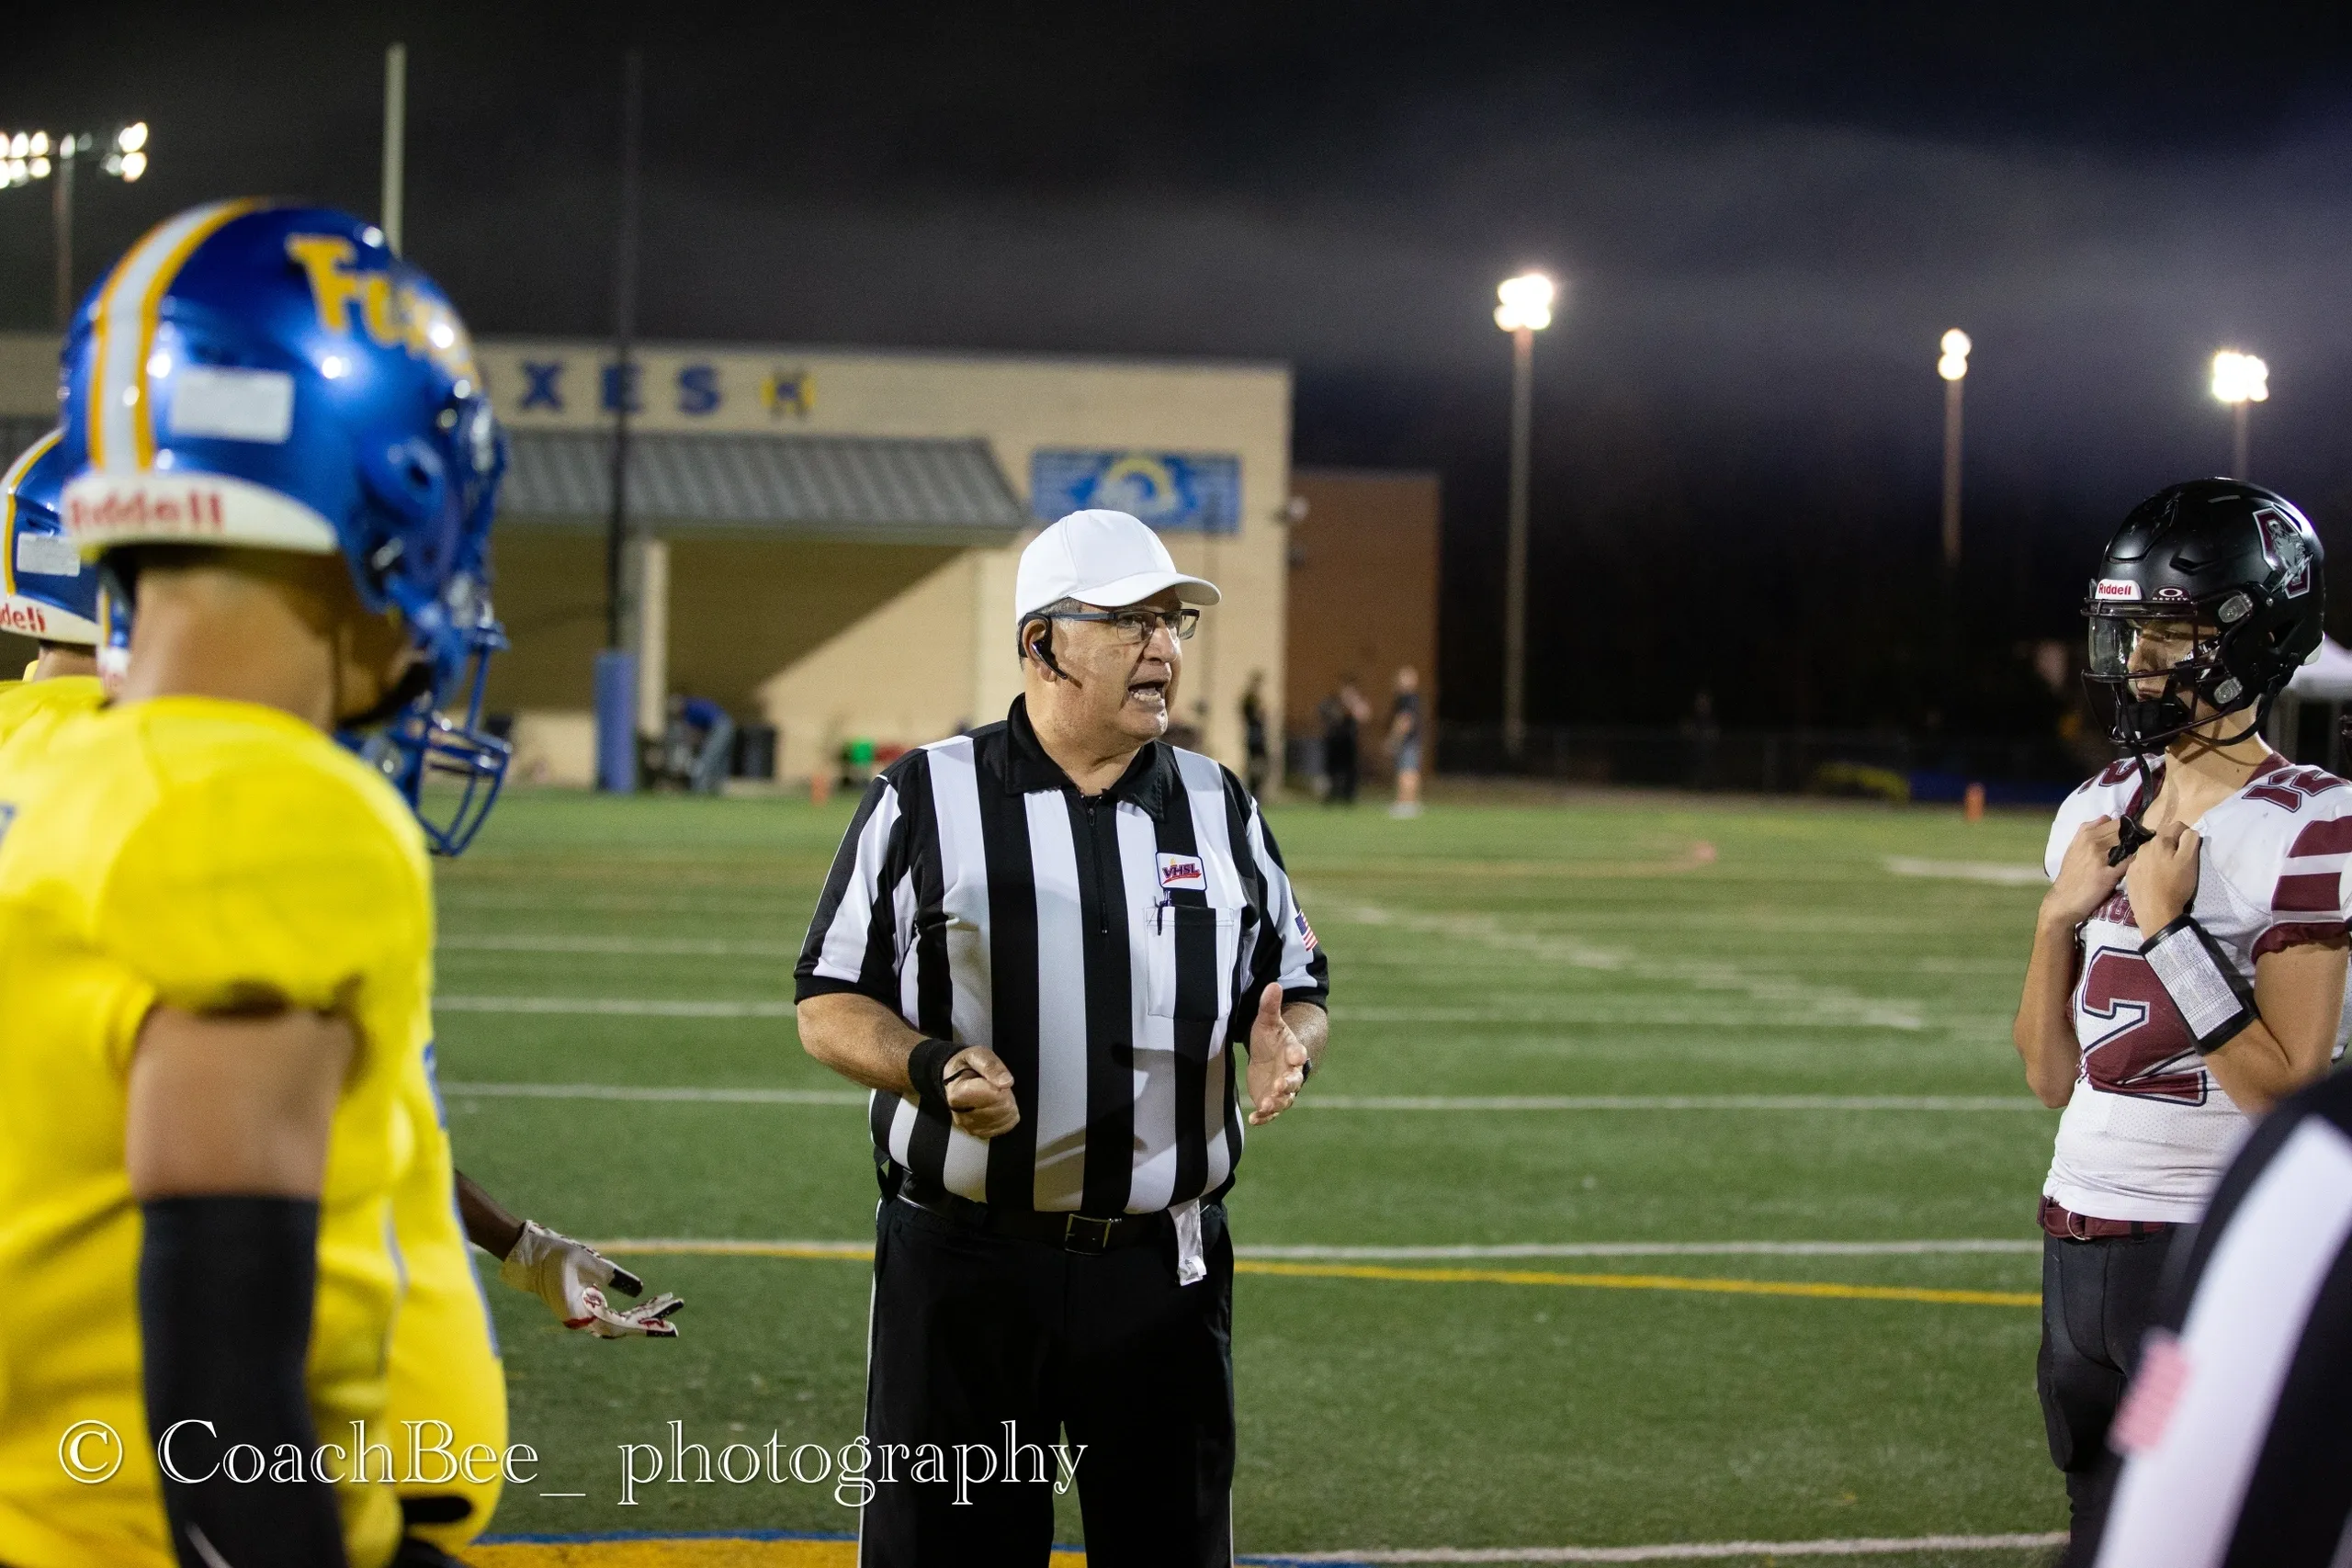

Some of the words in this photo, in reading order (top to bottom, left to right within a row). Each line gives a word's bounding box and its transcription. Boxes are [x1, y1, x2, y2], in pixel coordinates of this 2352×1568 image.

[2098, 582, 2132, 596] Riddell
[0, 602, 47, 634] dell
[1161, 863, 1201, 879] VHSL
